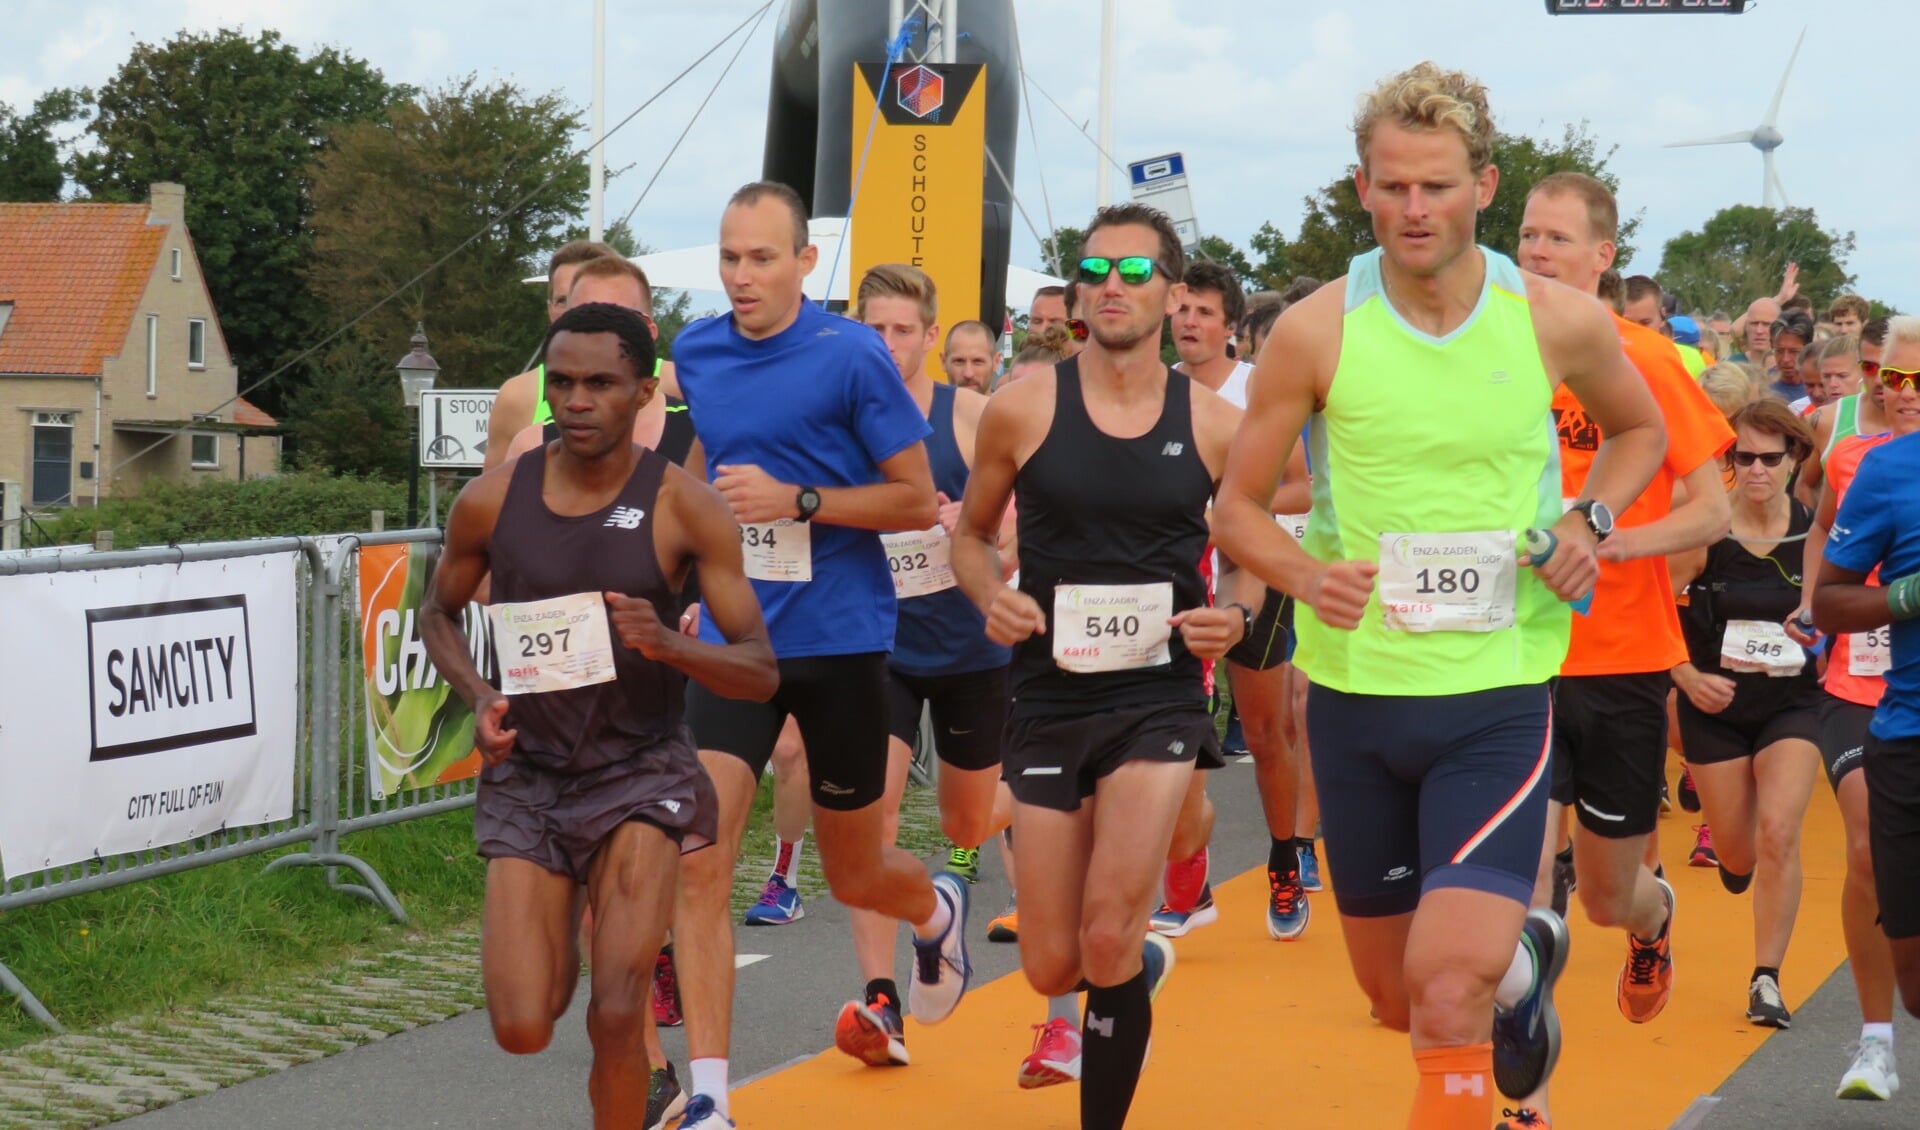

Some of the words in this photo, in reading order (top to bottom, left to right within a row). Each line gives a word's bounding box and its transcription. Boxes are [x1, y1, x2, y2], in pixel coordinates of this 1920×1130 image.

[1413, 547, 1440, 556] ENZA
[1443, 546, 1478, 555] ZADEN
[1477, 555, 1502, 564] LOOP
[1416, 568, 1480, 594] 180
[1085, 615, 1139, 638] 540
[519, 628, 571, 658] 297
[1745, 640, 1783, 657] 545
[107, 635, 235, 718] SAMCITY
[128, 794, 157, 820] CITY
[158, 788, 185, 815] FULL
[188, 784, 202, 809] OF
[202, 780, 224, 806] FUN
